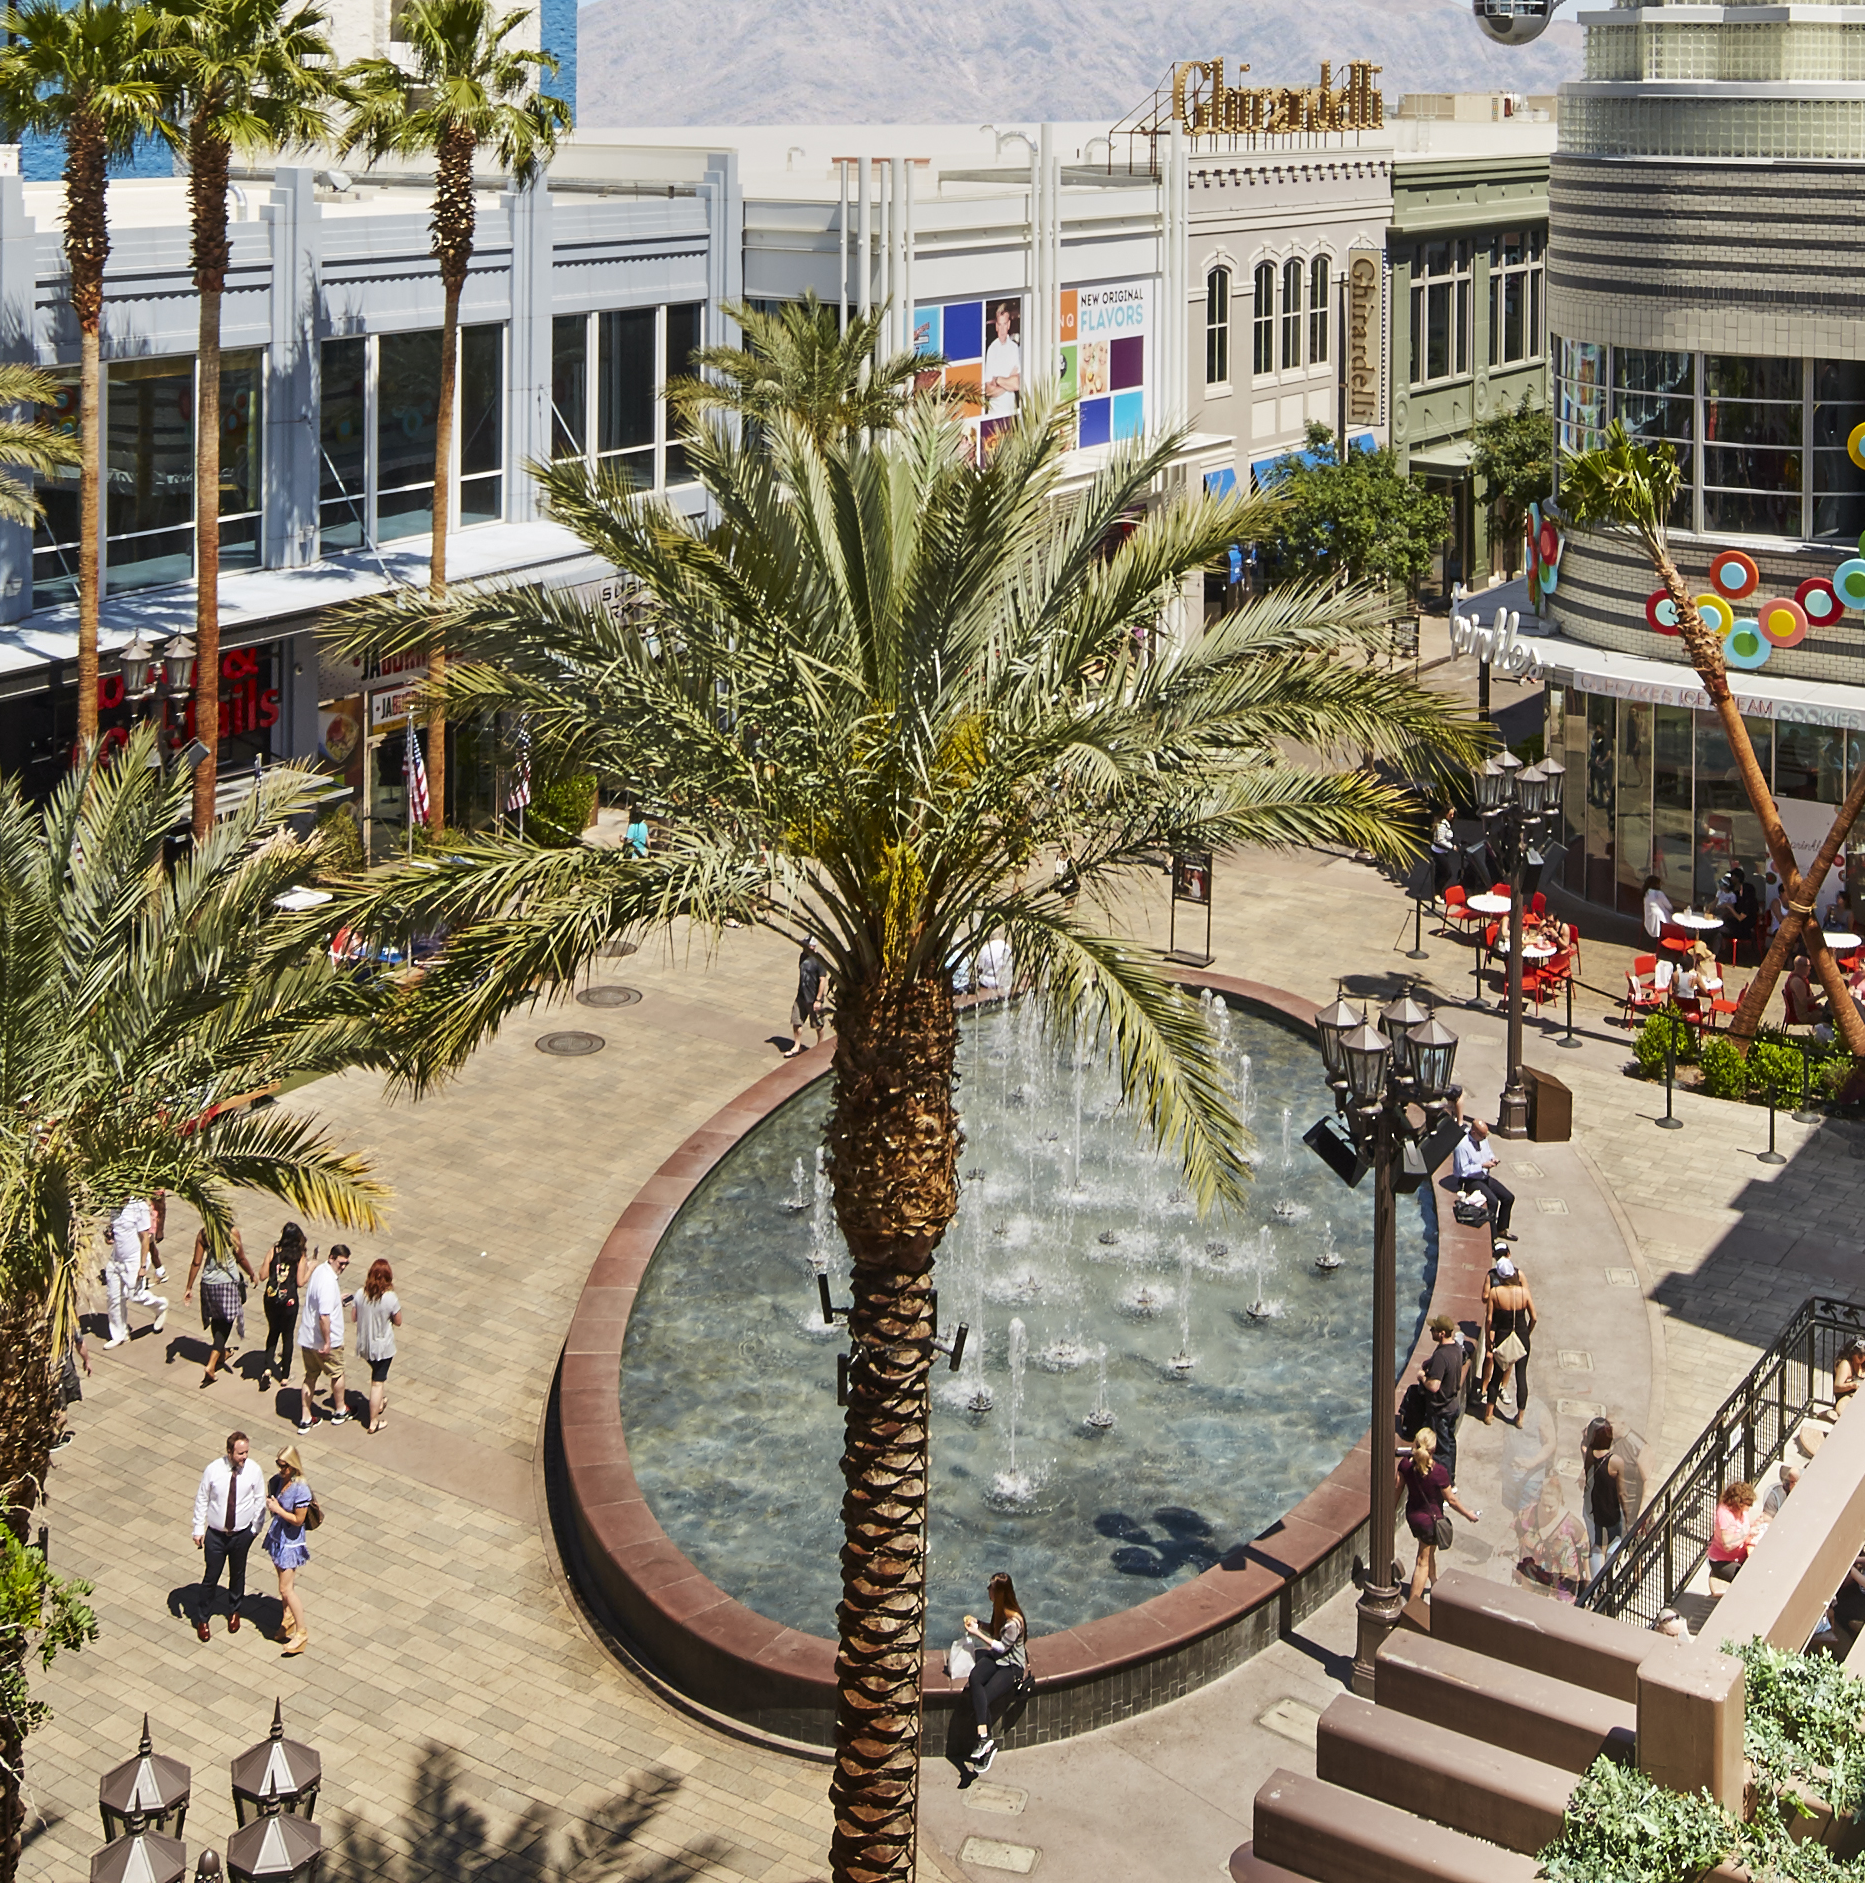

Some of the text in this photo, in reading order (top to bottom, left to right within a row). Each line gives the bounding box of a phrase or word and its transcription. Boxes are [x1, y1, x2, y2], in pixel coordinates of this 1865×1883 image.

[1172, 56, 1384, 136] Ghirardelli
[1080, 304, 1144, 332] FLAVORS
[1081, 288, 1144, 307] NEW ORIGINAL
[1351, 258, 1377, 417] Ghirardelli
[1580, 674, 1675, 706] CUPCAKES
[1678, 689, 1705, 706] ICE
[1779, 703, 1863, 728] COOKIES
